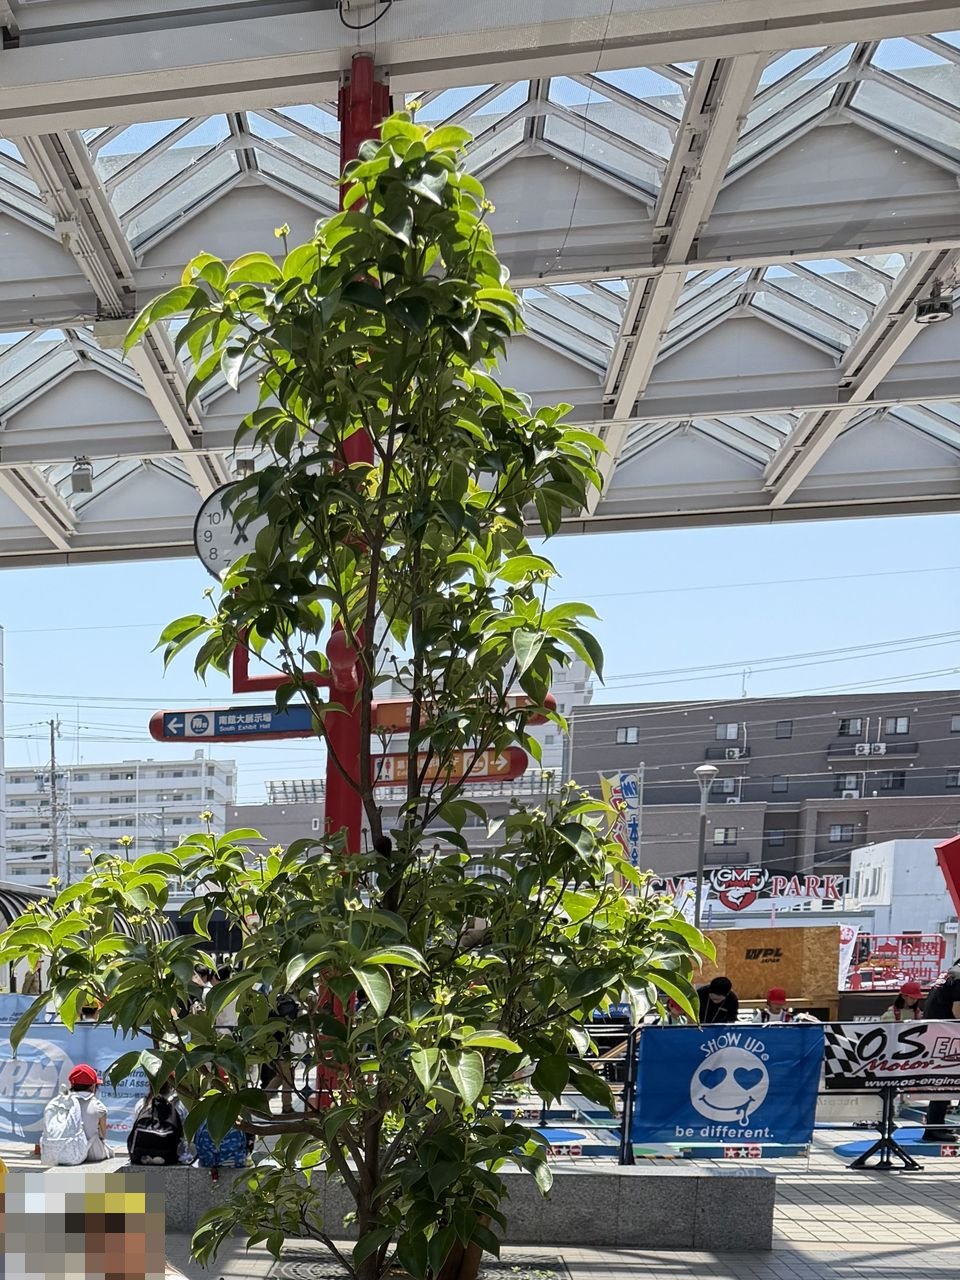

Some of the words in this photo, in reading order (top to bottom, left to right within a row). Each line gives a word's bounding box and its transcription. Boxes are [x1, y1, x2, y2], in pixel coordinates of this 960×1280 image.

[207, 512, 221, 525] 10
[204, 530, 213, 542] 9
[209, 548, 218, 560] 8
[218, 713, 272, 725] 南館大展示場
[717, 868, 762, 882] GMF
[771, 874, 844, 900] PARK
[745, 947, 783, 960] WPL
[700, 1032, 742, 1057] SHOW
[675, 1126, 694, 1137] be
[700, 1125, 775, 1138] different.
